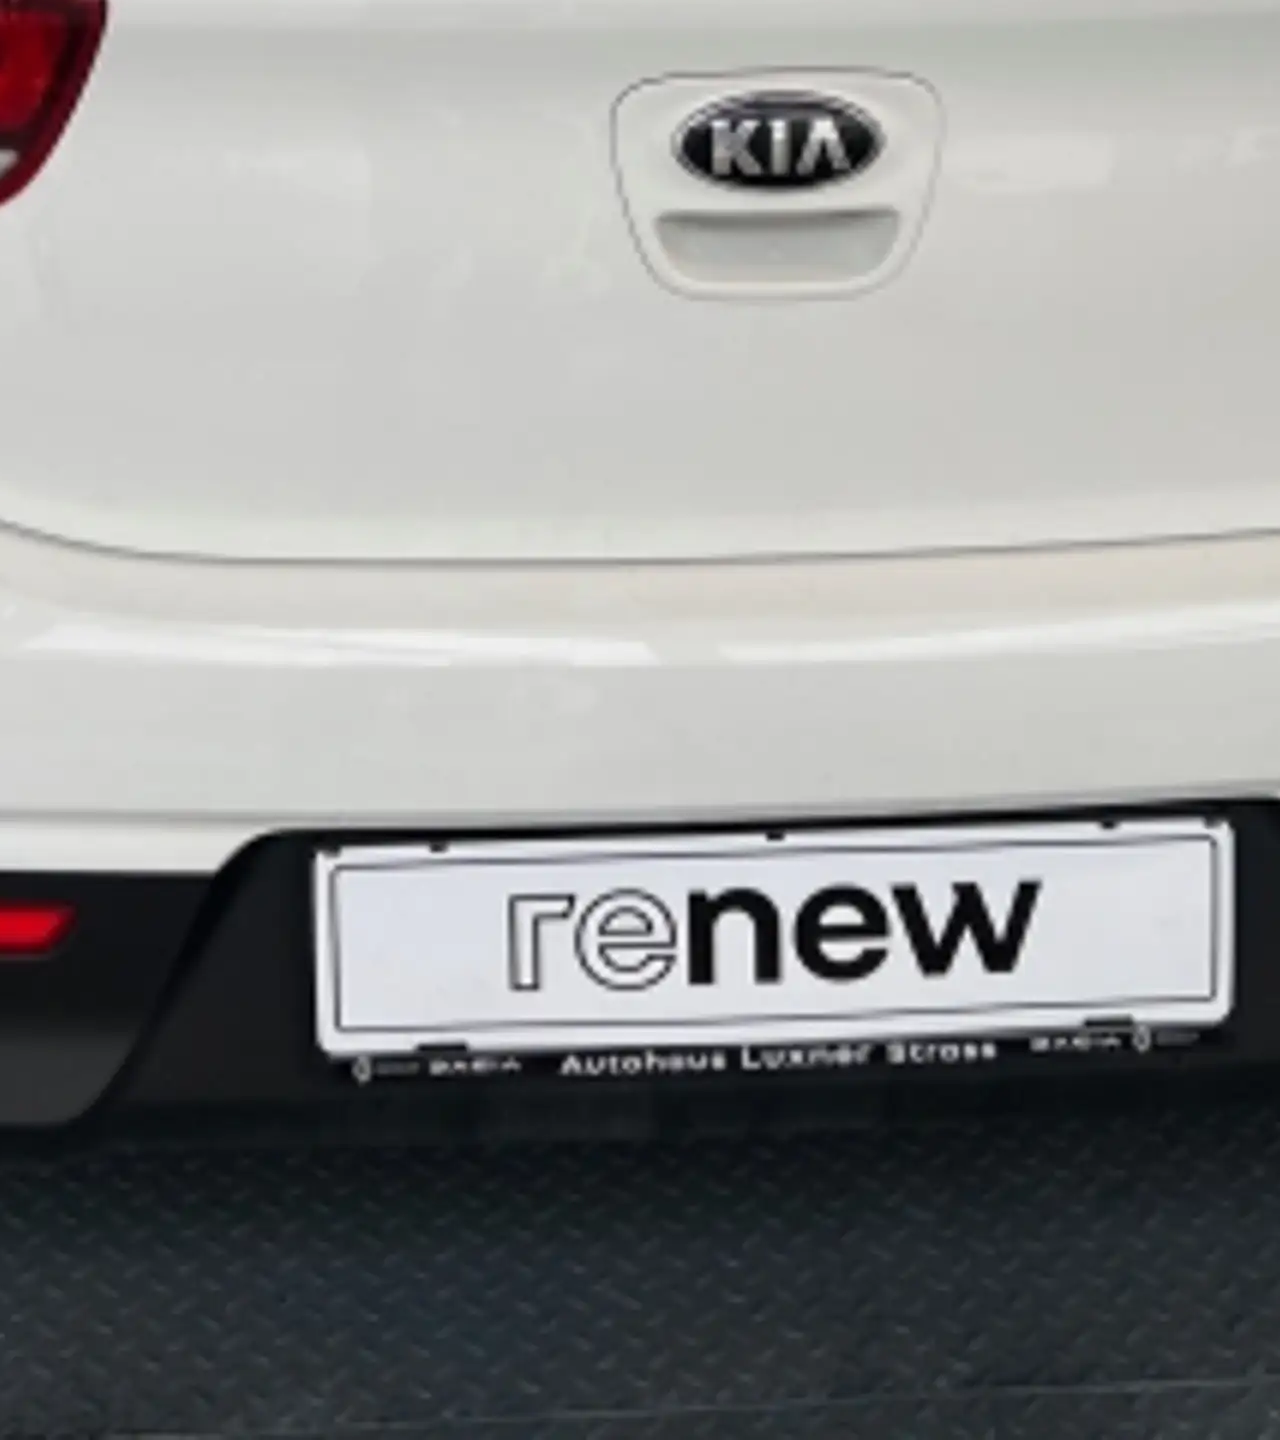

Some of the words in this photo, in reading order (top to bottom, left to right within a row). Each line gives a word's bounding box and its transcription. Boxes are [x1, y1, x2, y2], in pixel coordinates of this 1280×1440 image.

[710, 116, 851, 177] KIA
[508, 879, 1044, 992] renew
[559, 1050, 727, 1076] Autohaus
